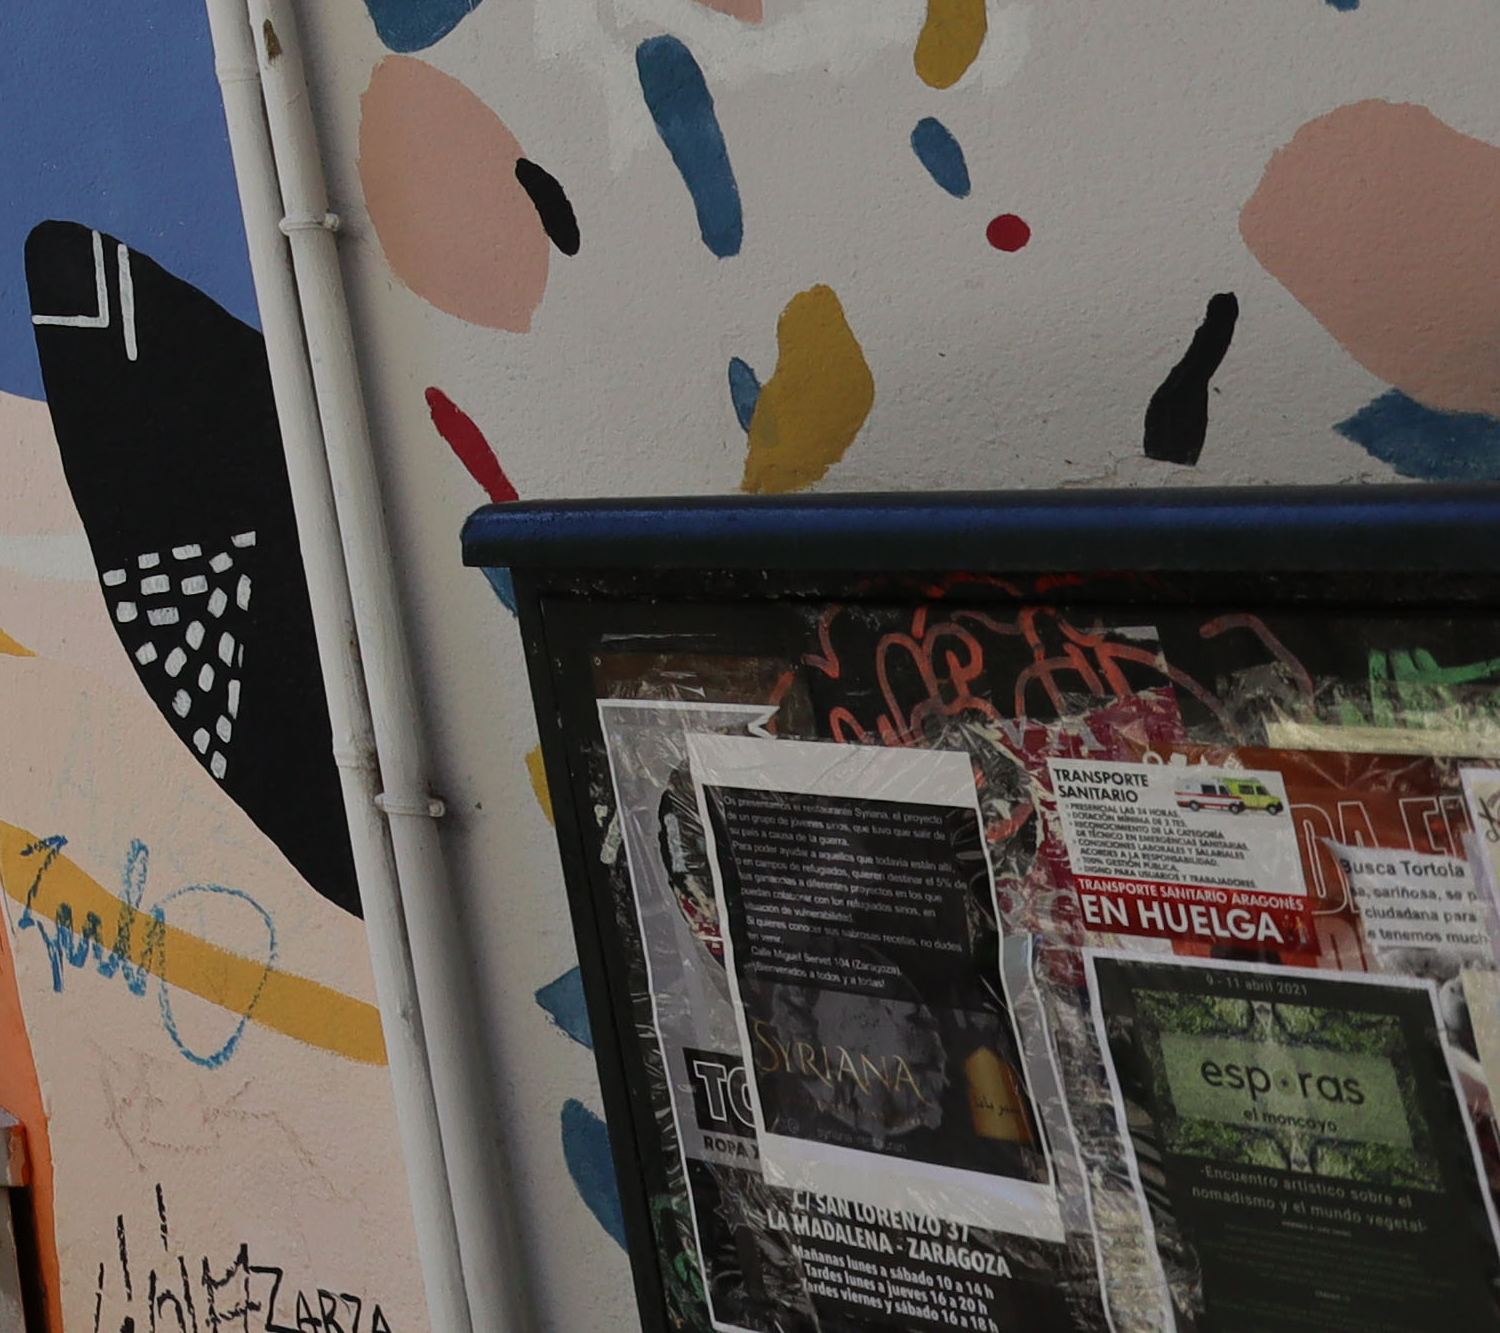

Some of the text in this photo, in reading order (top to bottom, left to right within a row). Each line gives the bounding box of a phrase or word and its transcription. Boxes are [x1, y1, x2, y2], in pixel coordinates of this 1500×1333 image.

[1053, 768, 1149, 787] TRANSPORTE
[1058, 785, 1138, 803] SANITARIO
[903, 814, 942, 824] proyecto
[1400, 860, 1465, 878] Tortola
[1078, 878, 1304, 912] TRANSPORTE SANITARIO ARAGONÉS
[1081, 894, 1285, 945] EN HUELGA
[1365, 906, 1477, 924] ciudadana para
[1380, 928, 1442, 943] tenemos
[834, 957, 850, 968] 104
[1245, 979, 1274, 993] abril
[1278, 982, 1307, 996] 2021
[754, 1020, 933, 1108] SYRIANA
[1243, 1109, 1337, 1133] el moncayo
[703, 1135, 751, 1155] ROPA
[1192, 1186, 1275, 1209] nomadismo
[1279, 1200, 1287, 1214] y
[1292, 1200, 1306, 1214] el
[1310, 1204, 1362, 1224] mundo
[1283, 1176, 1345, 1198] artístico
[1349, 1188, 1392, 1206] sobre
[1397, 1194, 1412, 1208] el
[815, 1193, 851, 1219] SAN
[853, 1201, 941, 1238] LORENZO
[766, 1208, 1013, 1279] LA MADALENA ZARAGOZA
[792, 1244, 994, 1300] Mañanas lunes a sábado 10 a 14 h
[804, 1263, 988, 1315] Tardes lunes a jueves 16 a 20 h
[801, 1277, 999, 1333] Tardes viernes y sábado 16 a 18 h
